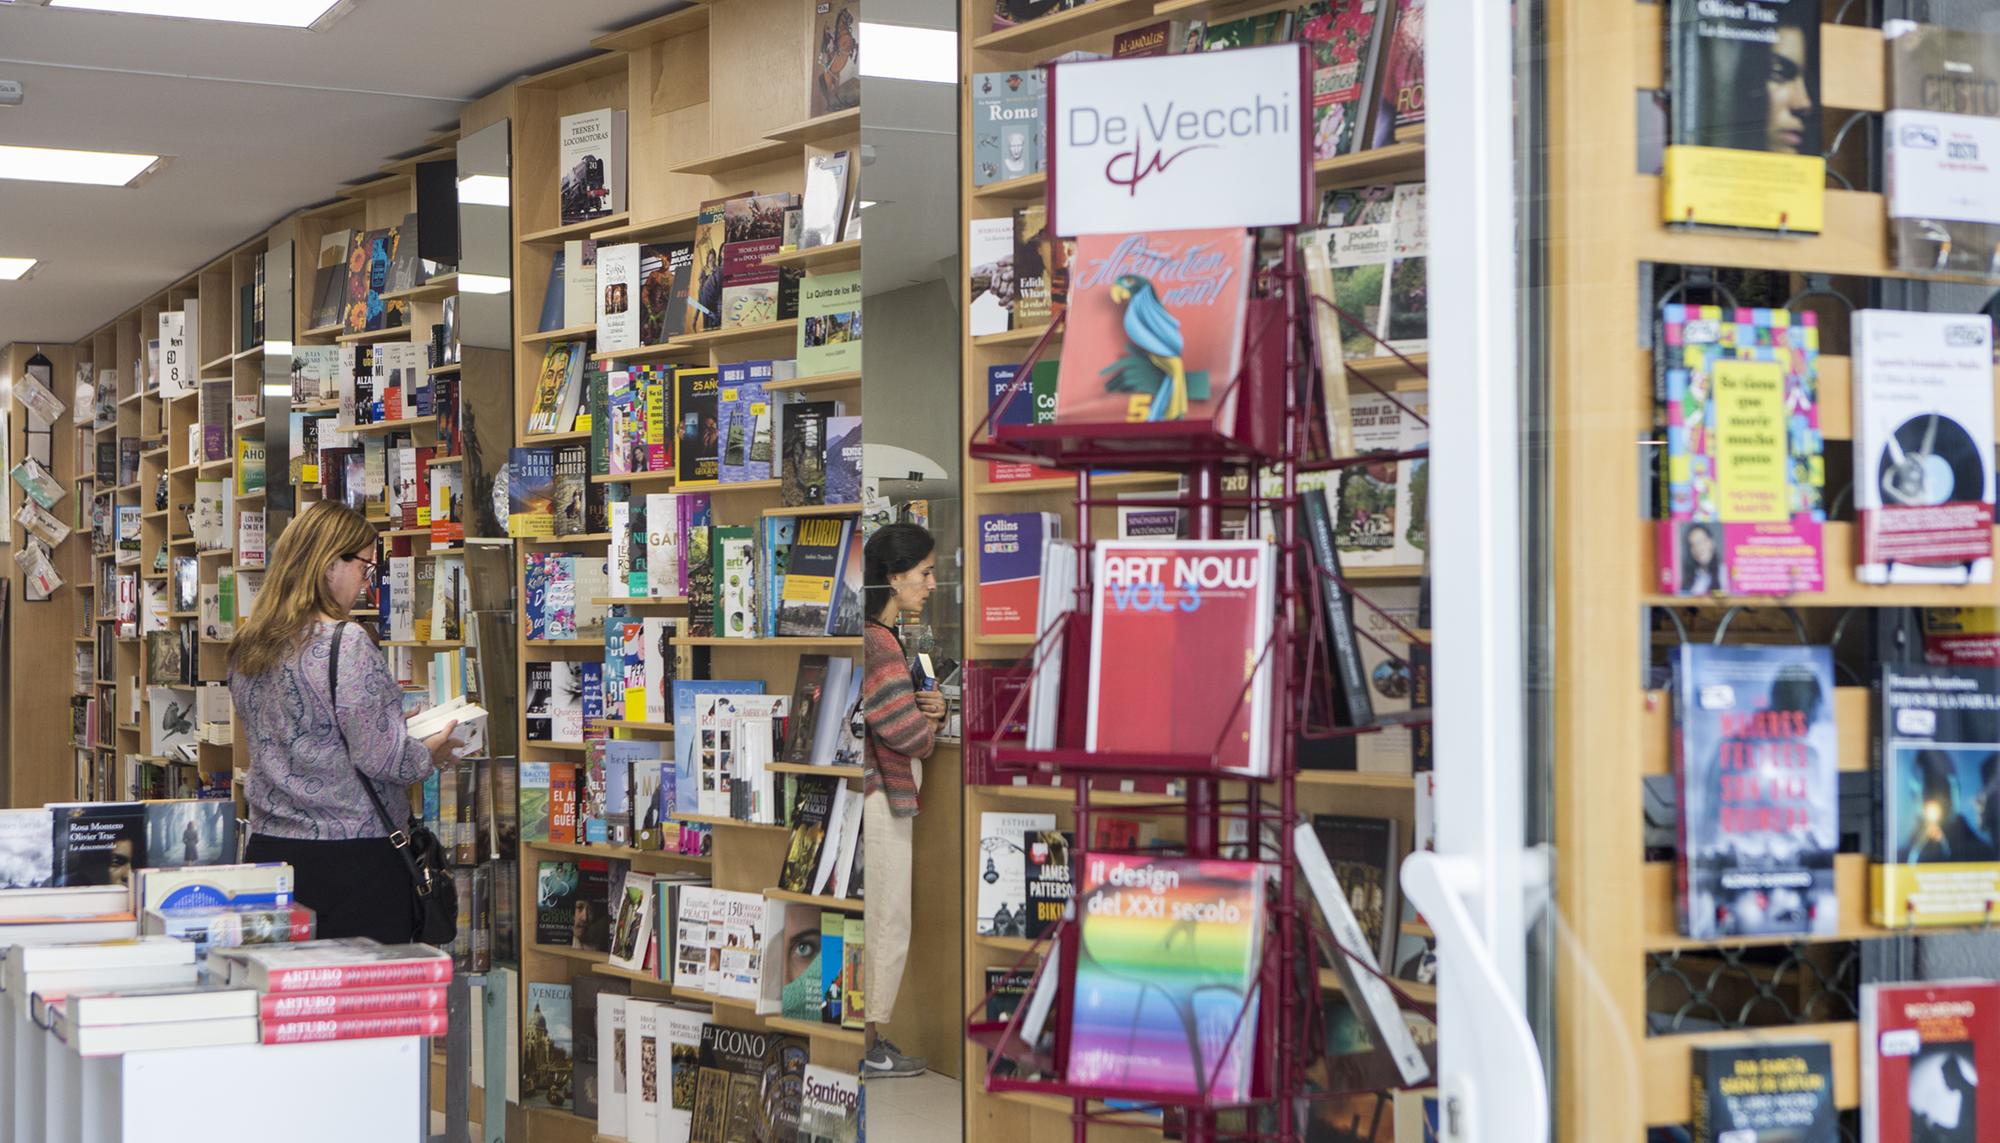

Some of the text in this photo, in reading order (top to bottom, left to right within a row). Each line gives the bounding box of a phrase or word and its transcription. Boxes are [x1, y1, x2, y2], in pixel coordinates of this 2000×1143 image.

[990, 105, 1038, 121] Roma
[1069, 91, 1289, 147] De Vecchi
[1020, 277, 1044, 289] Edith
[806, 291, 814, 299] La
[814, 288, 832, 299] Quinta
[833, 287, 841, 296] de
[842, 286, 850, 295] los
[994, 371, 1014, 379] Collins
[1126, 393, 1153, 423] 5
[528, 412, 556, 432] WILL
[797, 519, 842, 547] MADRID
[984, 519, 1019, 532] Collins
[984, 532, 1019, 542] first time
[1104, 556, 1259, 589] ART NOW
[1111, 581, 1201, 613] VOL 3
[70, 822, 124, 831] Rosa Montero
[1001, 817, 1037, 827] ESTHER
[69, 831, 116, 841] Olivier Truc
[69, 843, 78, 851] La
[1038, 865, 1070, 882] JAMES
[1090, 861, 1180, 895] Il design
[727, 901, 743, 916] 150
[1087, 891, 1241, 924] del XXI secolo
[282, 968, 342, 982] ARTURO
[532, 988, 572, 1000] VENECIA
[276, 995, 336, 1010] ARTURO
[276, 1020, 337, 1035] ARTURO
[702, 1026, 766, 1059] EL ICONO
